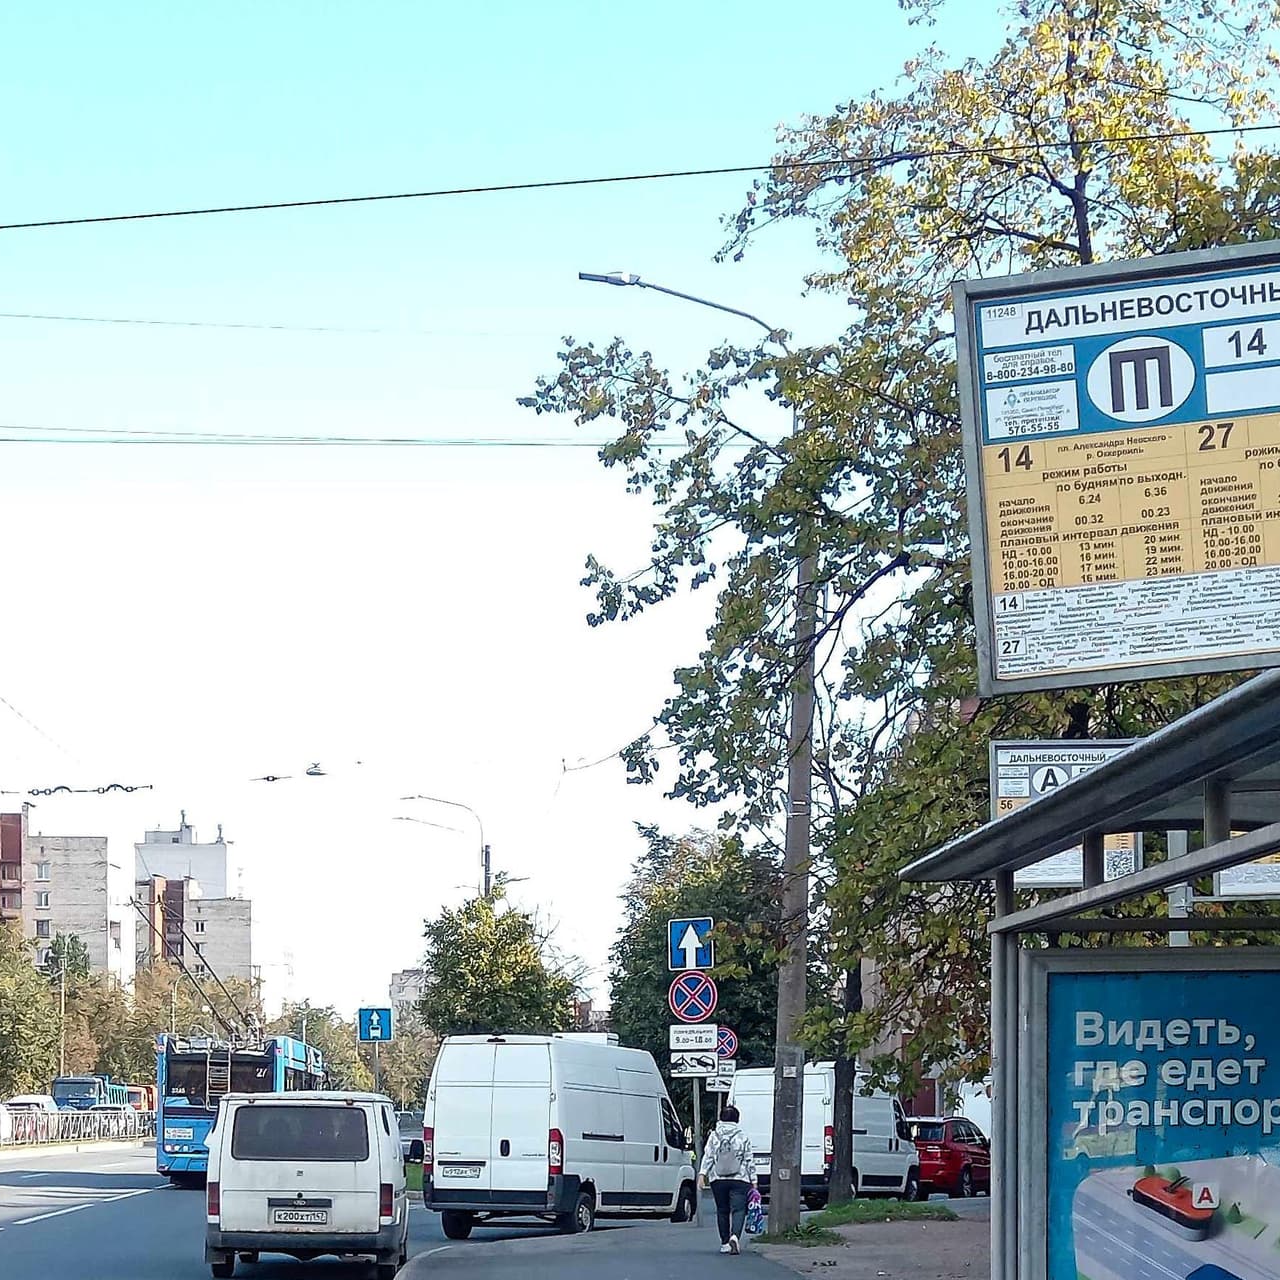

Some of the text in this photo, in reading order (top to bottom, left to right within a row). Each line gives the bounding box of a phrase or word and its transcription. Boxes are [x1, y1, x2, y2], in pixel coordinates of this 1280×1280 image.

[986, 306, 1016, 319] 11248
[1227, 327, 1267, 358] 14
[986, 362, 1074, 381] 8-800-234-98-80
[1198, 422, 1234, 451] 27
[1073, 438, 1125, 451] Александра
[998, 445, 1033, 472] 14
[1259, 460, 1274, 470] по
[1042, 463, 1128, 482] режим работы
[1119, 471, 1188, 486] по выходн.
[1056, 478, 1119, 492] по будням
[1200, 475, 1237, 486] начало
[1078, 493, 1101, 505] 6.24
[1144, 486, 1168, 498] 6.36
[998, 497, 1036, 509] начало
[999, 504, 1051, 518] движения
[1141, 506, 1171, 519] 00.23
[1000, 515, 1055, 528] окончание
[1074, 513, 1104, 526] 00.32
[1201, 511, 1263, 526] плановый
[1000, 521, 1180, 548] плановый интервал движения
[1203, 527, 1219, 538] НД
[1228, 524, 1255, 535] 10.00
[1079, 542, 1090, 551] 13
[1143, 535, 1156, 544] 20
[1204, 534, 1261, 549] 10.00-16.00
[1001, 549, 1018, 560] НД
[1026, 546, 1052, 557] 10.00
[1079, 552, 1091, 562] 16
[1145, 545, 1157, 555] 19
[1204, 545, 1262, 559] 16.00-20.00
[1002, 556, 1058, 570] 10.00-16.00
[1080, 563, 1092, 572] 17
[1145, 556, 1157, 566] 22
[1205, 559, 1232, 570] 20.00
[1241, 555, 1257, 567] ОД
[1003, 566, 1059, 581] 16.00-20.00
[1080, 573, 1092, 583] 16
[1146, 567, 1158, 576] 23
[1003, 580, 1030, 591] 20.00
[1039, 577, 1055, 589] ОД
[1000, 596, 1019, 611] 14
[1002, 640, 1020, 654] 27
[1009, 752, 1106, 763] ДАЛЬНЕВОСТОЧНЫЙ
[1040, 768, 1059, 792] А
[1000, 800, 1013, 810] 56
[1075, 1011, 1256, 1052] Видеть,
[1074, 1058, 1266, 1091] где едет
